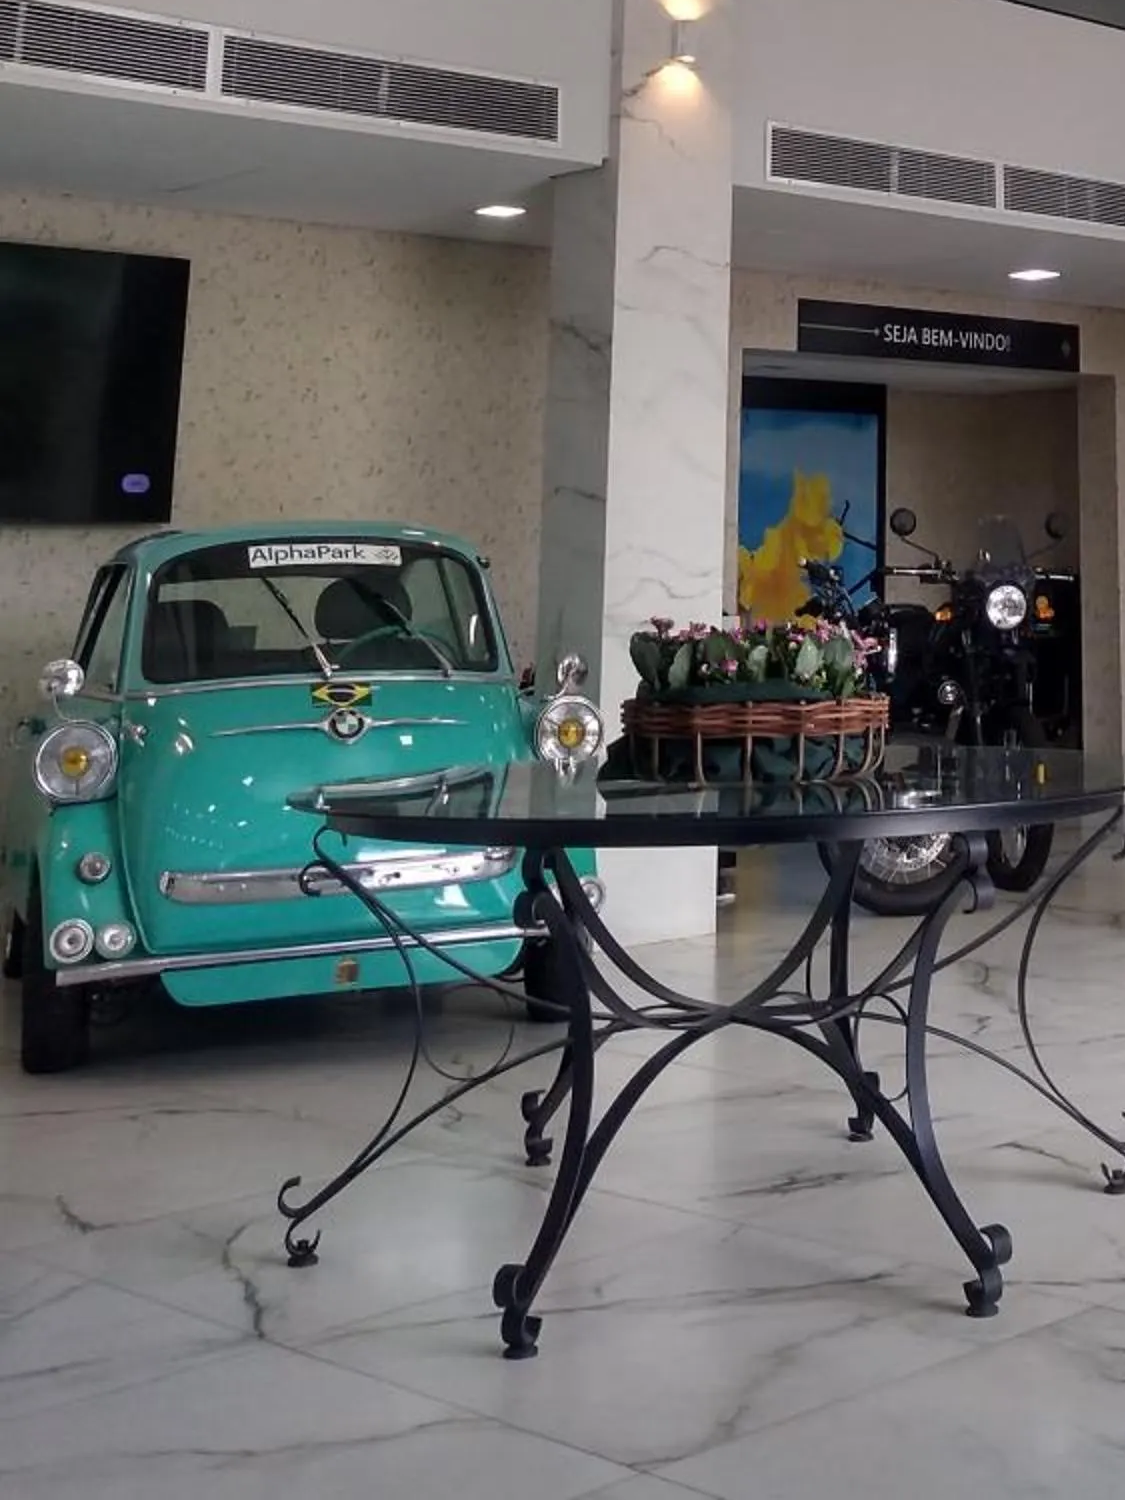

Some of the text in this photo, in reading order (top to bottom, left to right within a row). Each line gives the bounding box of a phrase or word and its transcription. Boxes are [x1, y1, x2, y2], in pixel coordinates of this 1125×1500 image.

[883, 323, 1011, 352] SEJA BEM-VINDO!
[251, 544, 366, 564] AlphaPark
